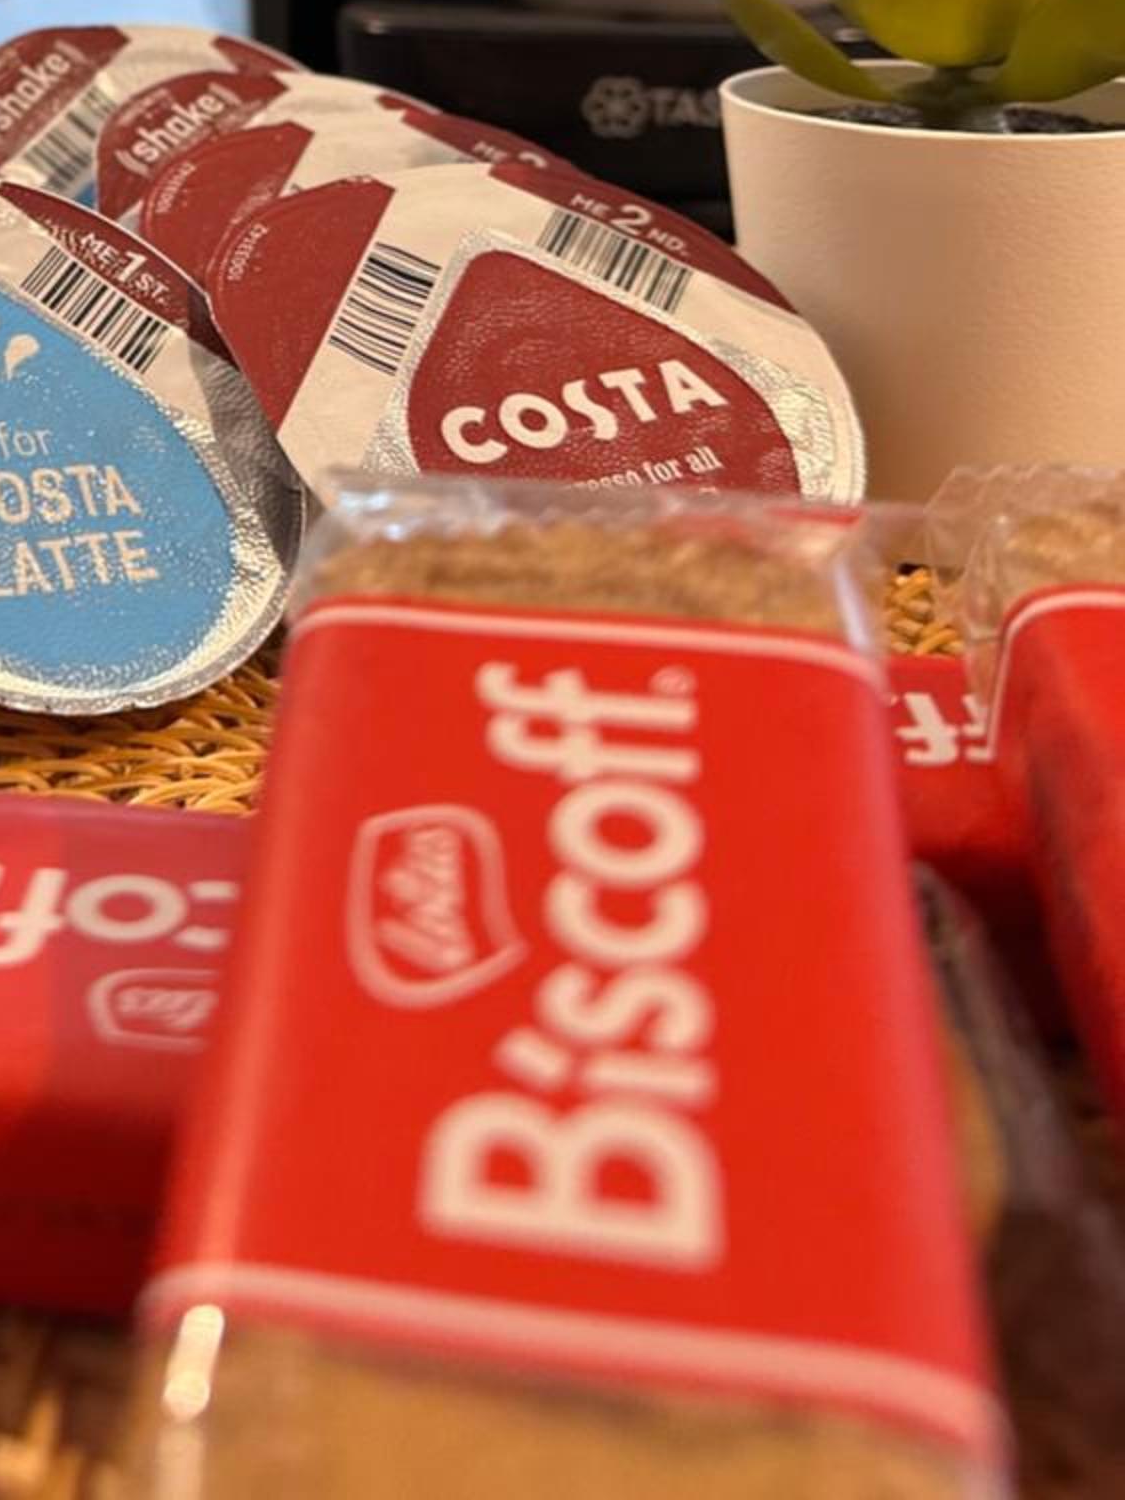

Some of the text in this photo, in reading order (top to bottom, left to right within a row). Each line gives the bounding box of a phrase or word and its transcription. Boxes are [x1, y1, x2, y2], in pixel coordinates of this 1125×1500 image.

[440, 358, 729, 465] COSTA
[642, 458, 683, 486] for
[684, 445, 725, 474] all
[419, 660, 728, 1274] Biscoff
